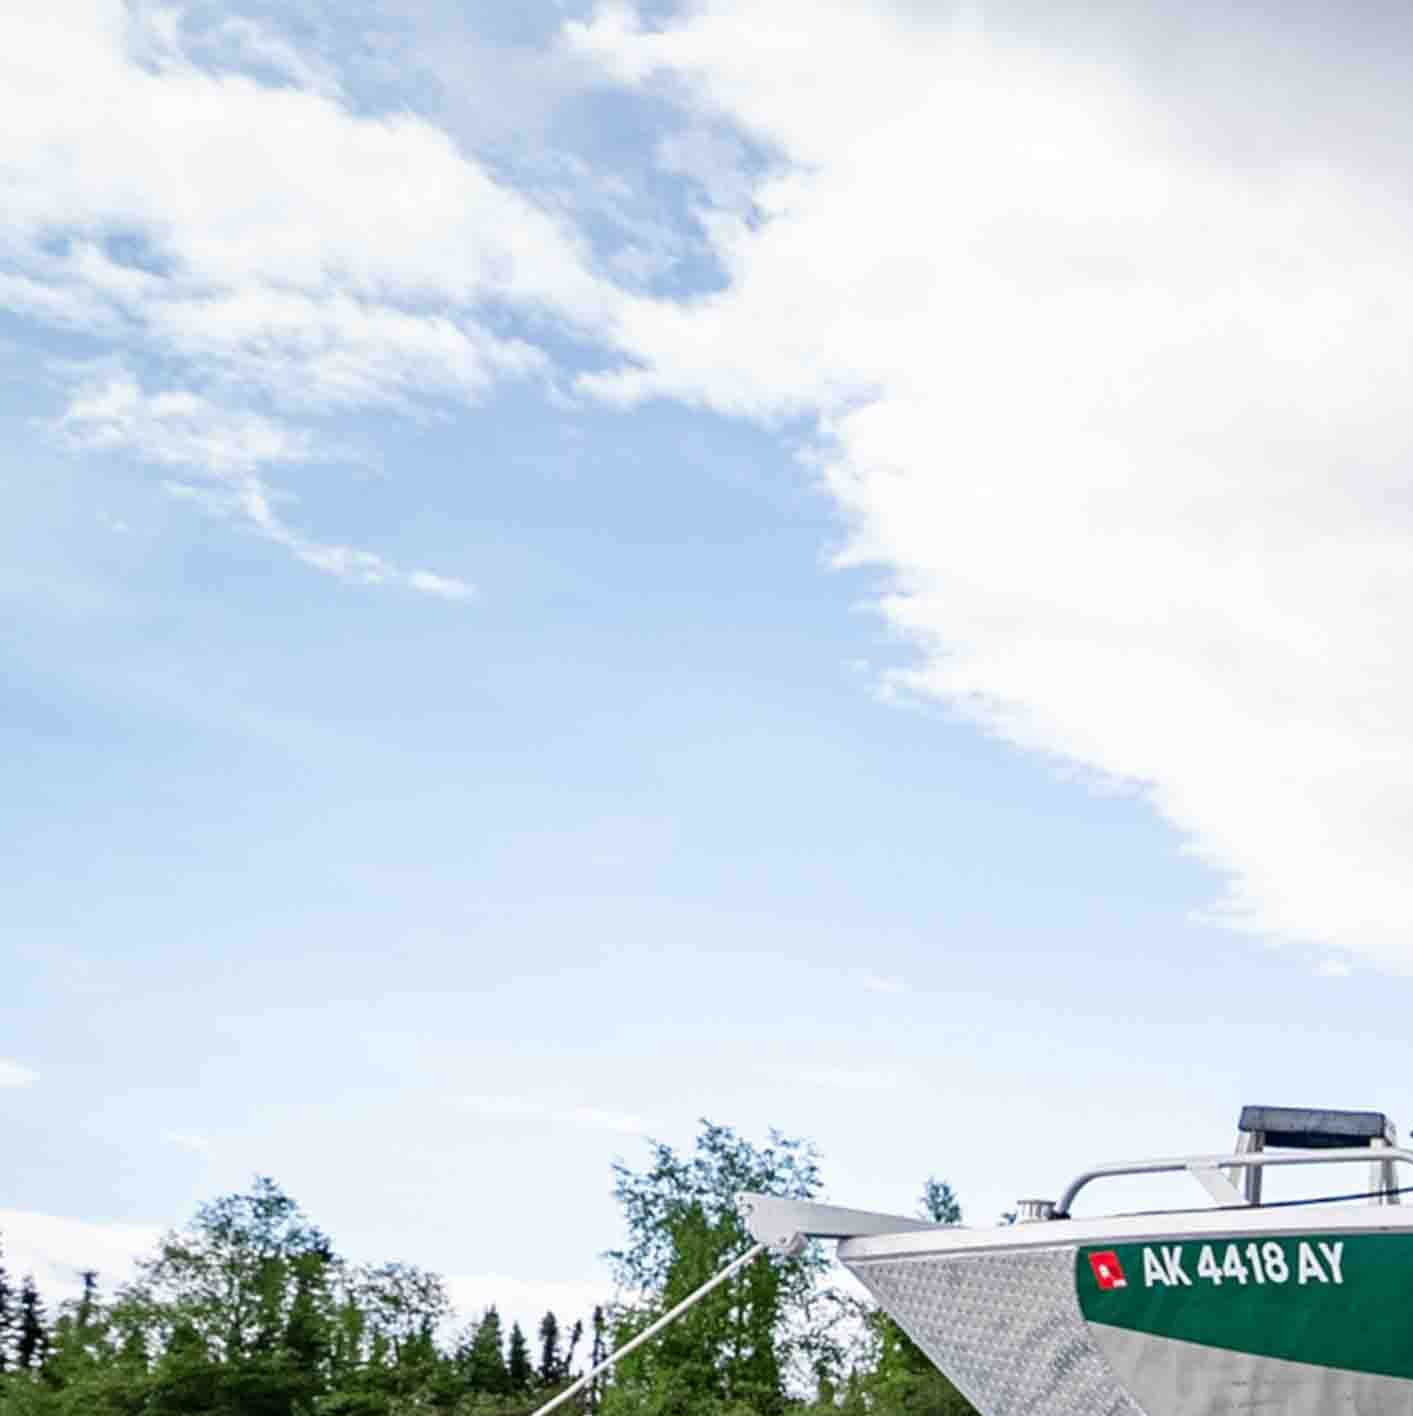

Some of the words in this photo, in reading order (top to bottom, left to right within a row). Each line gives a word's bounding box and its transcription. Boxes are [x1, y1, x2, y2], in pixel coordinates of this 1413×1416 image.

[1143, 1246, 1192, 1287] AK
[1197, 1242, 1289, 1285] 4418
[1298, 1240, 1344, 1285] AY
